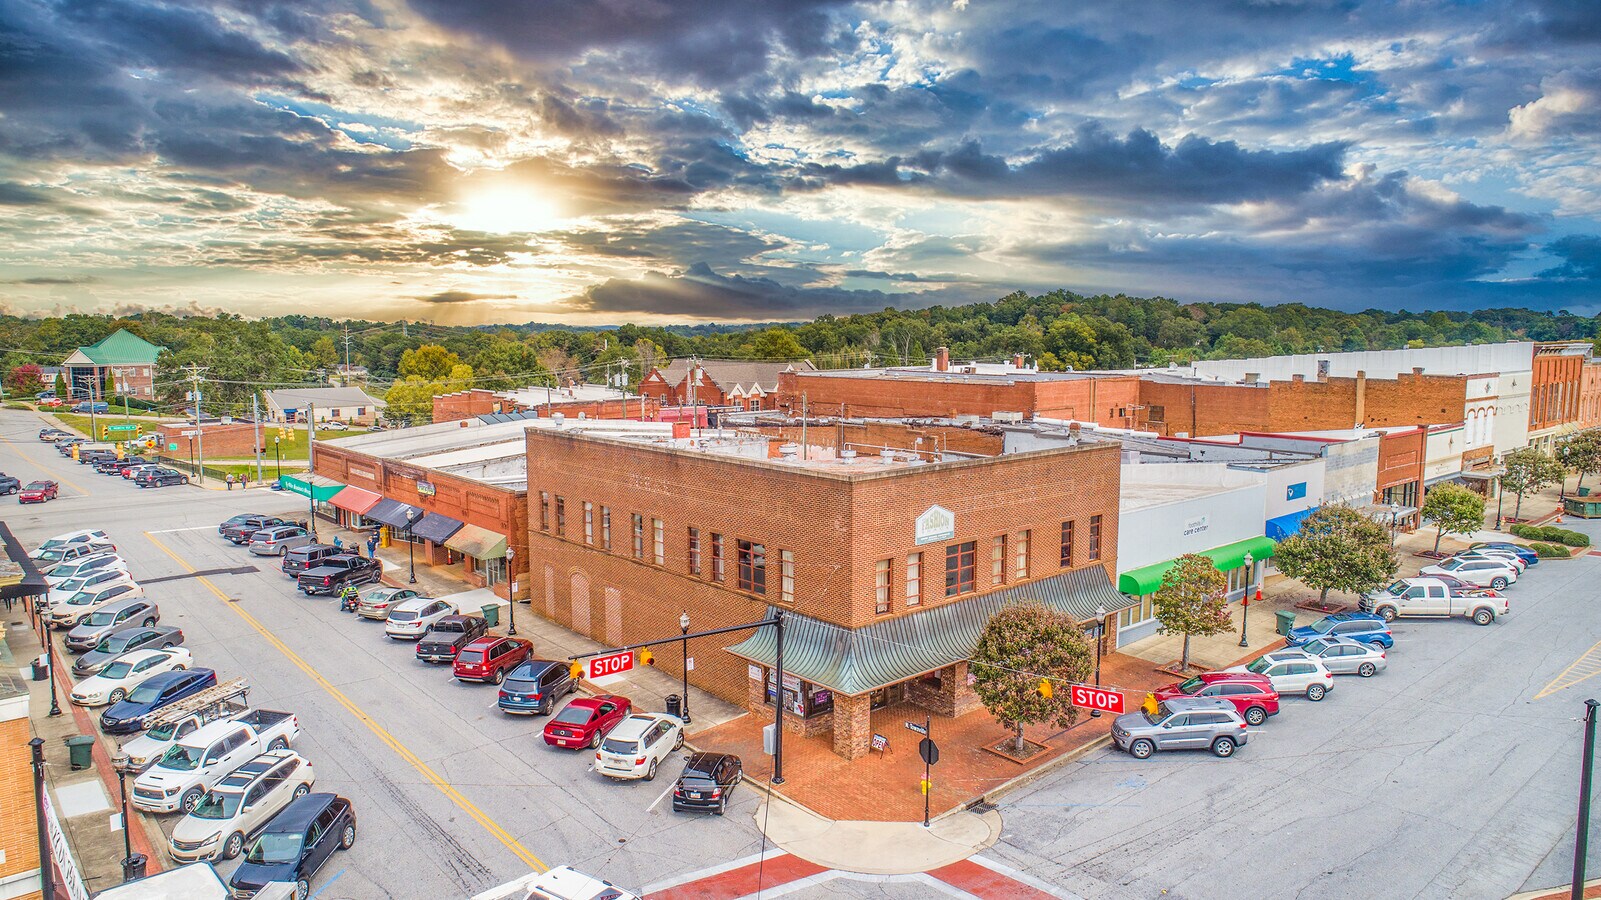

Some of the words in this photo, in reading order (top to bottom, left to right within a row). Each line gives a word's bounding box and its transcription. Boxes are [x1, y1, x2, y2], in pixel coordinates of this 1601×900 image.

[922, 509, 949, 534] FASHION
[1184, 528, 1194, 536] care
[1195, 525, 1209, 533] center
[594, 655, 630, 675] STOP
[1077, 689, 1119, 709] STOP
[872, 738, 884, 750] OPEN
